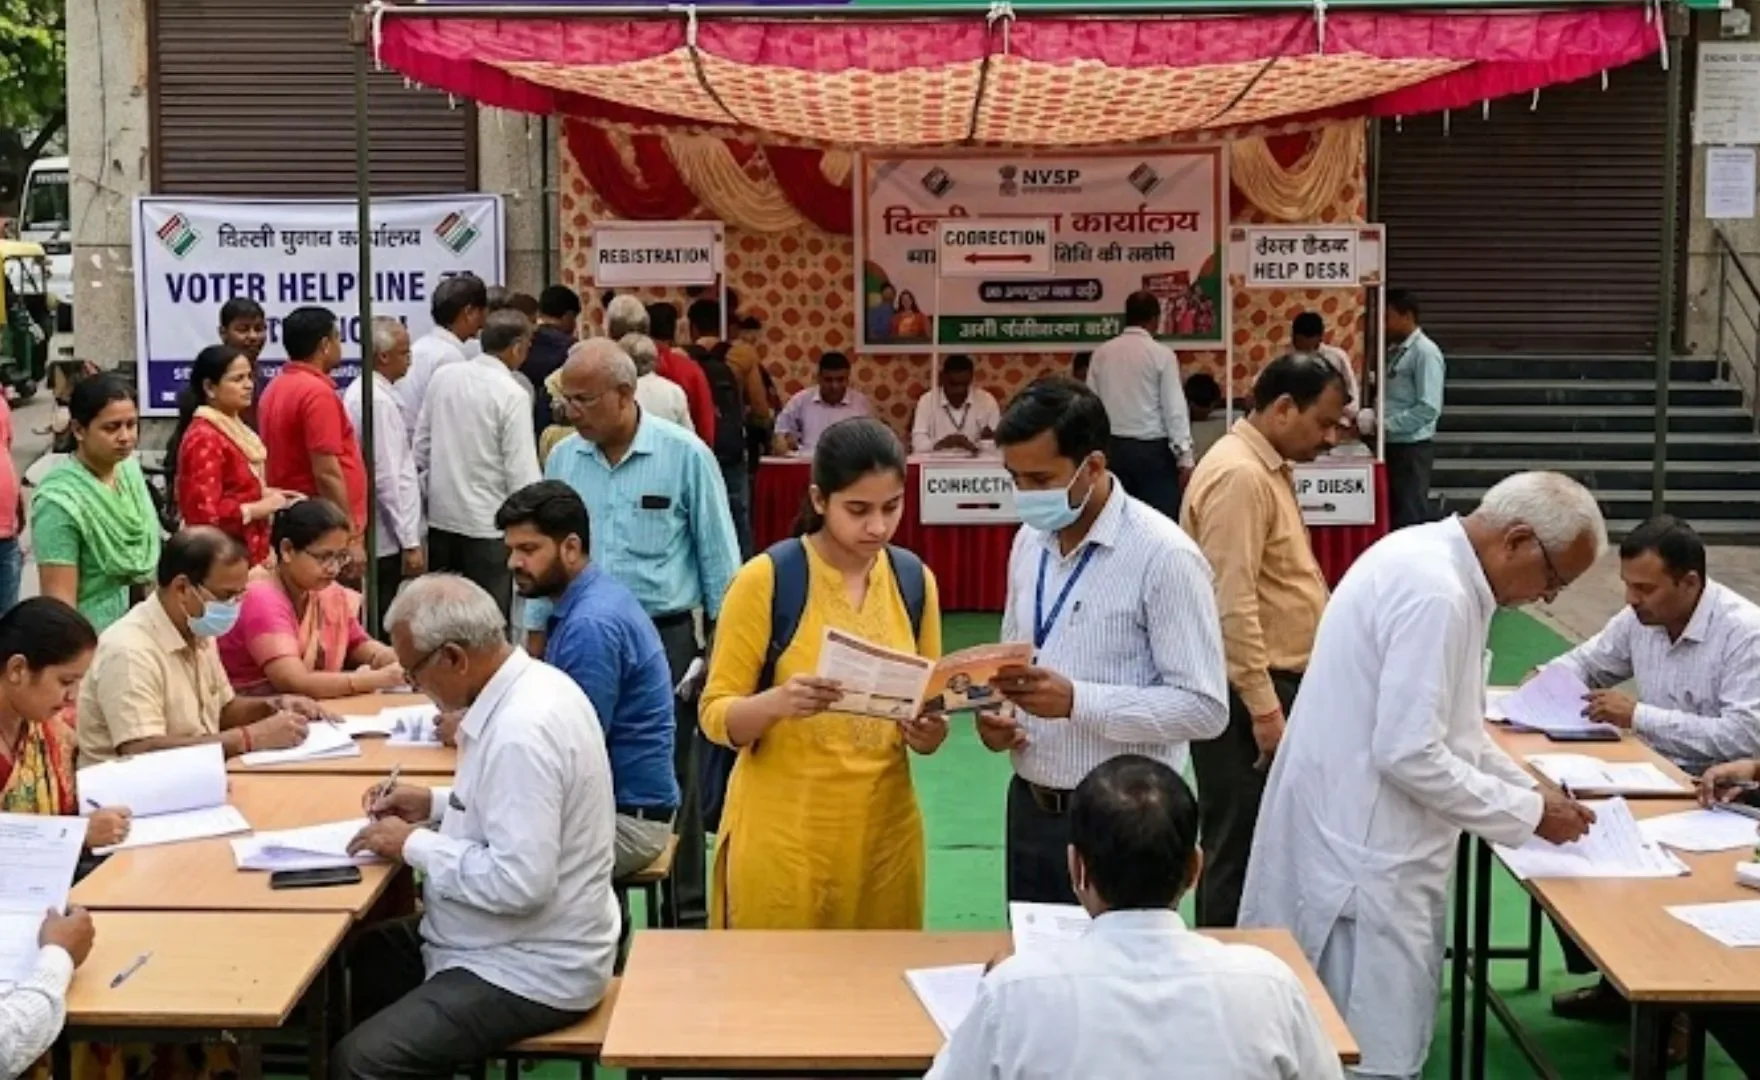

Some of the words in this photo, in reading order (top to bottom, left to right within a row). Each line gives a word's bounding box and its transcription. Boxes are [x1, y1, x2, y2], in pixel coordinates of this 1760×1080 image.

[1022, 169, 1081, 185] NVSP
[1071, 203, 1199, 234] कार्यालय
[1253, 262, 1299, 280] HELP
[165, 272, 266, 304] VOTER
[278, 272, 425, 304] HELPINE
